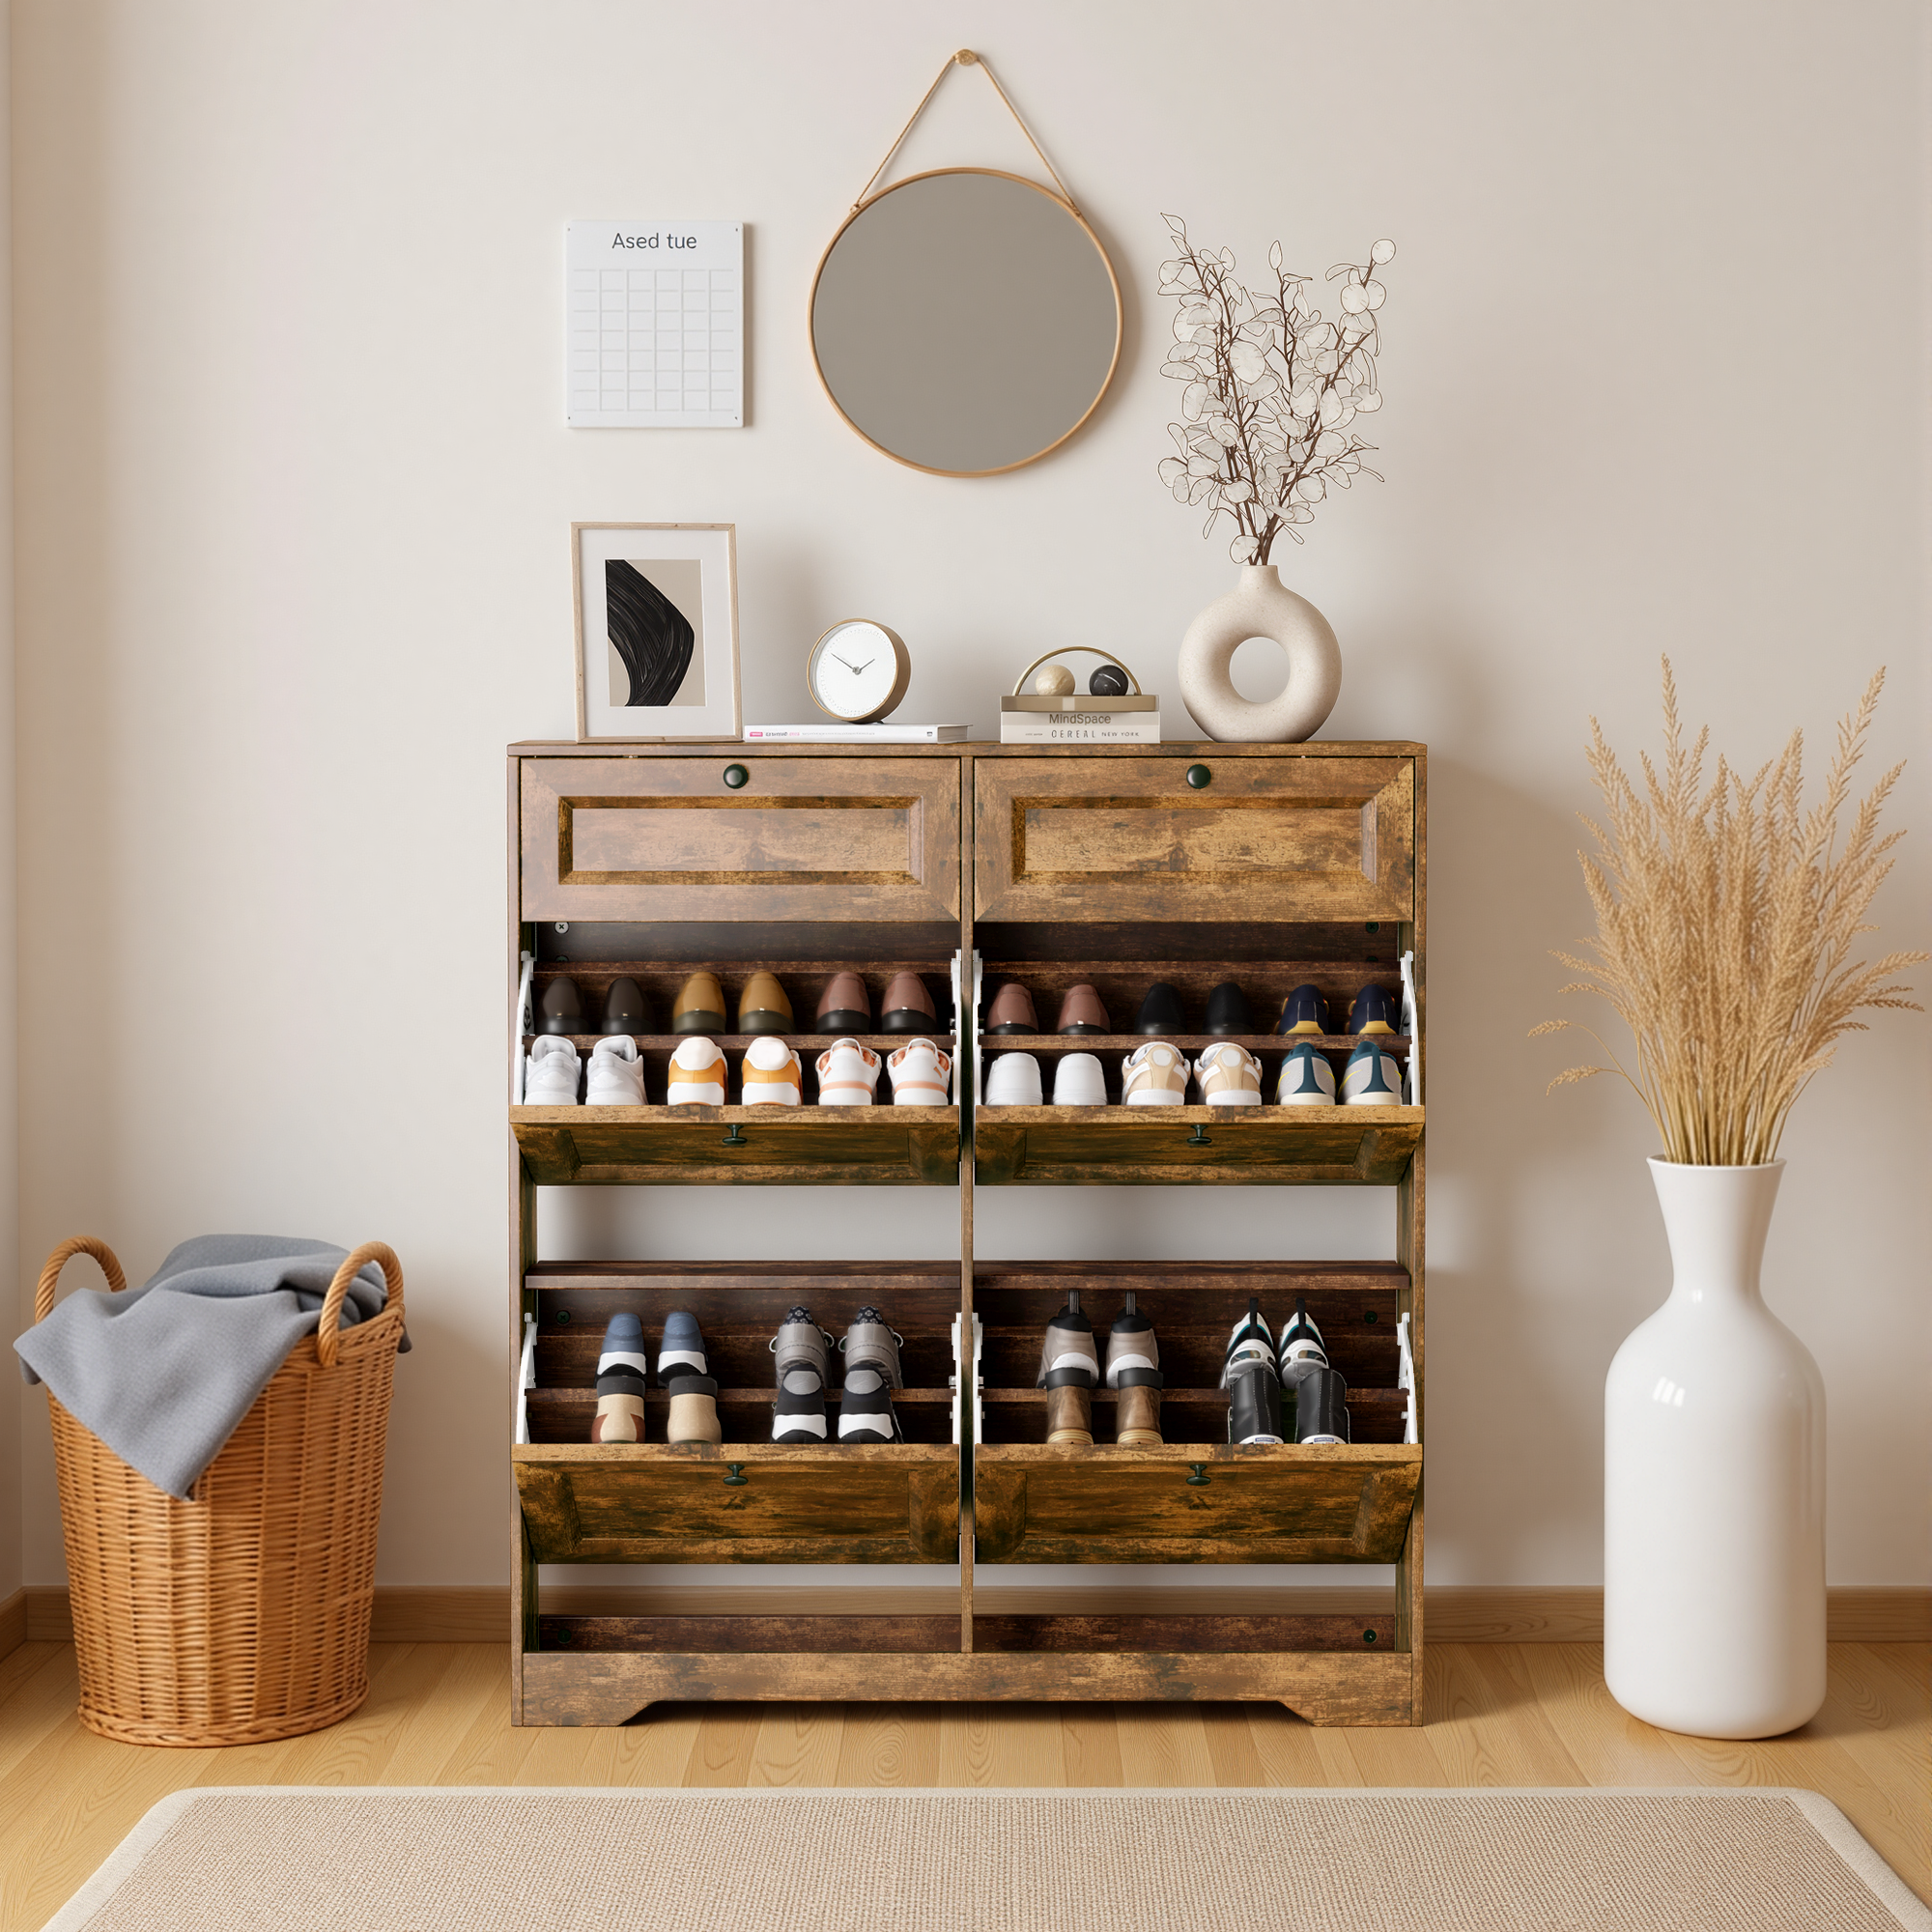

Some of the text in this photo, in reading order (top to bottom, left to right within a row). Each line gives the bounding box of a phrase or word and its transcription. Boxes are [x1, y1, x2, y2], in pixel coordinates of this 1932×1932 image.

[611, 233, 697, 249] Ased tue
[1049, 713, 1112, 725] MindSpace
